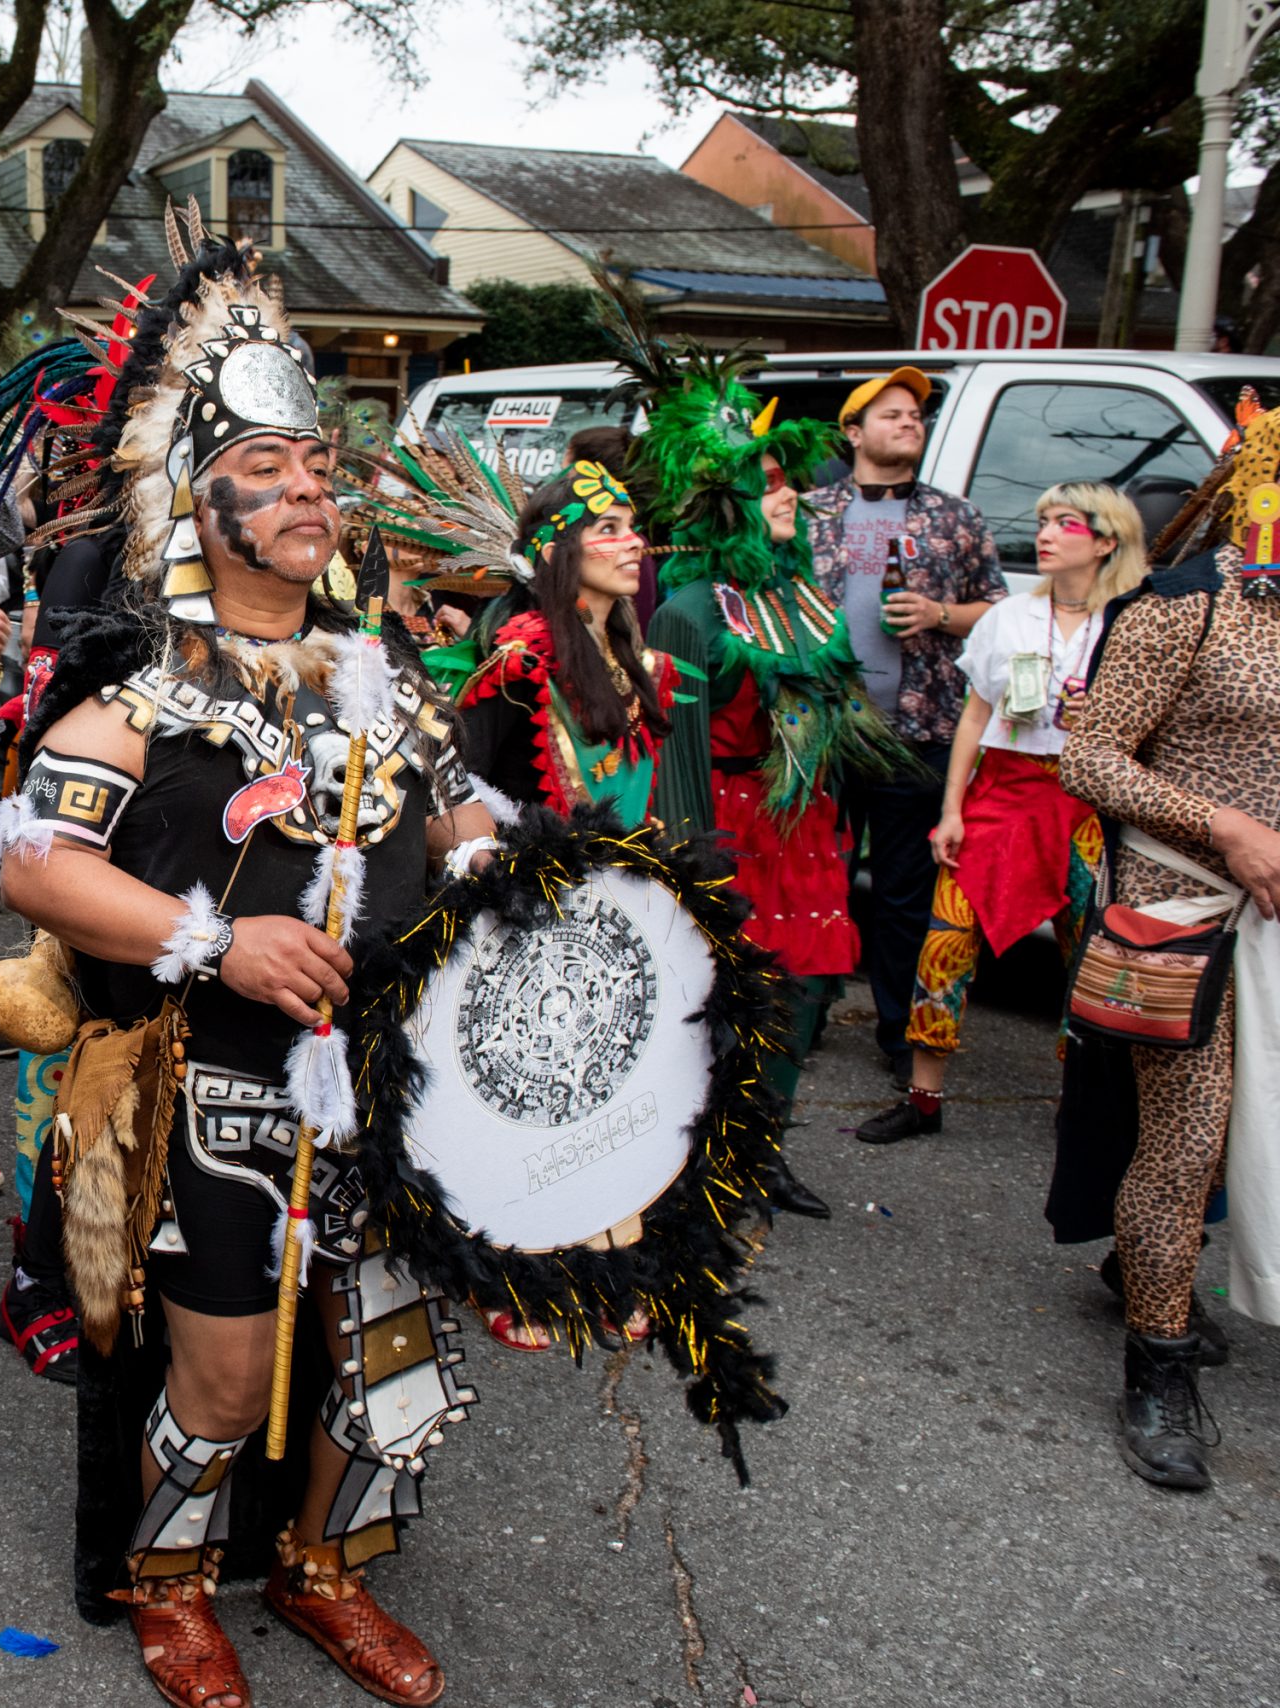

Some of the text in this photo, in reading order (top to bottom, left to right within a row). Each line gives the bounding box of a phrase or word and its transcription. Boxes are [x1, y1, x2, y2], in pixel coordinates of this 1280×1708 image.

[928, 297, 1054, 350] STOP
[493, 401, 552, 417] U-HAUL
[469, 440, 557, 477] uane
[523, 1091, 658, 1195] MEXICO
